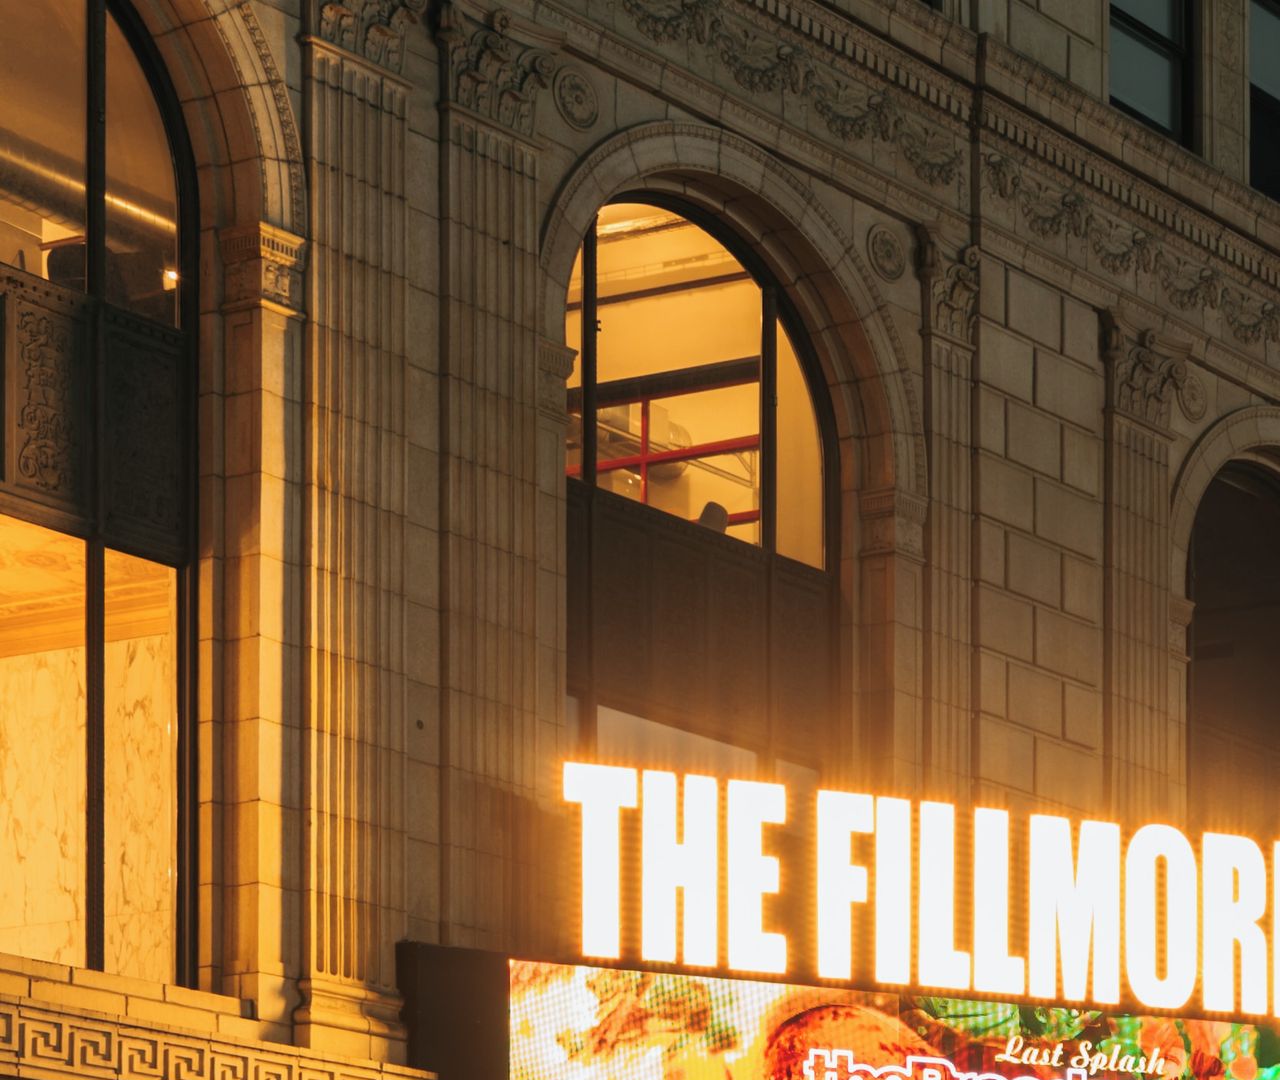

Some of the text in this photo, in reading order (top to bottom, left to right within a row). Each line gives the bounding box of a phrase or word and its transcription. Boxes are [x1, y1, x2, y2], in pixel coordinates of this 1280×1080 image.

[563, 762, 787, 974] THE
[995, 1036, 1165, 1076] Last Splash
